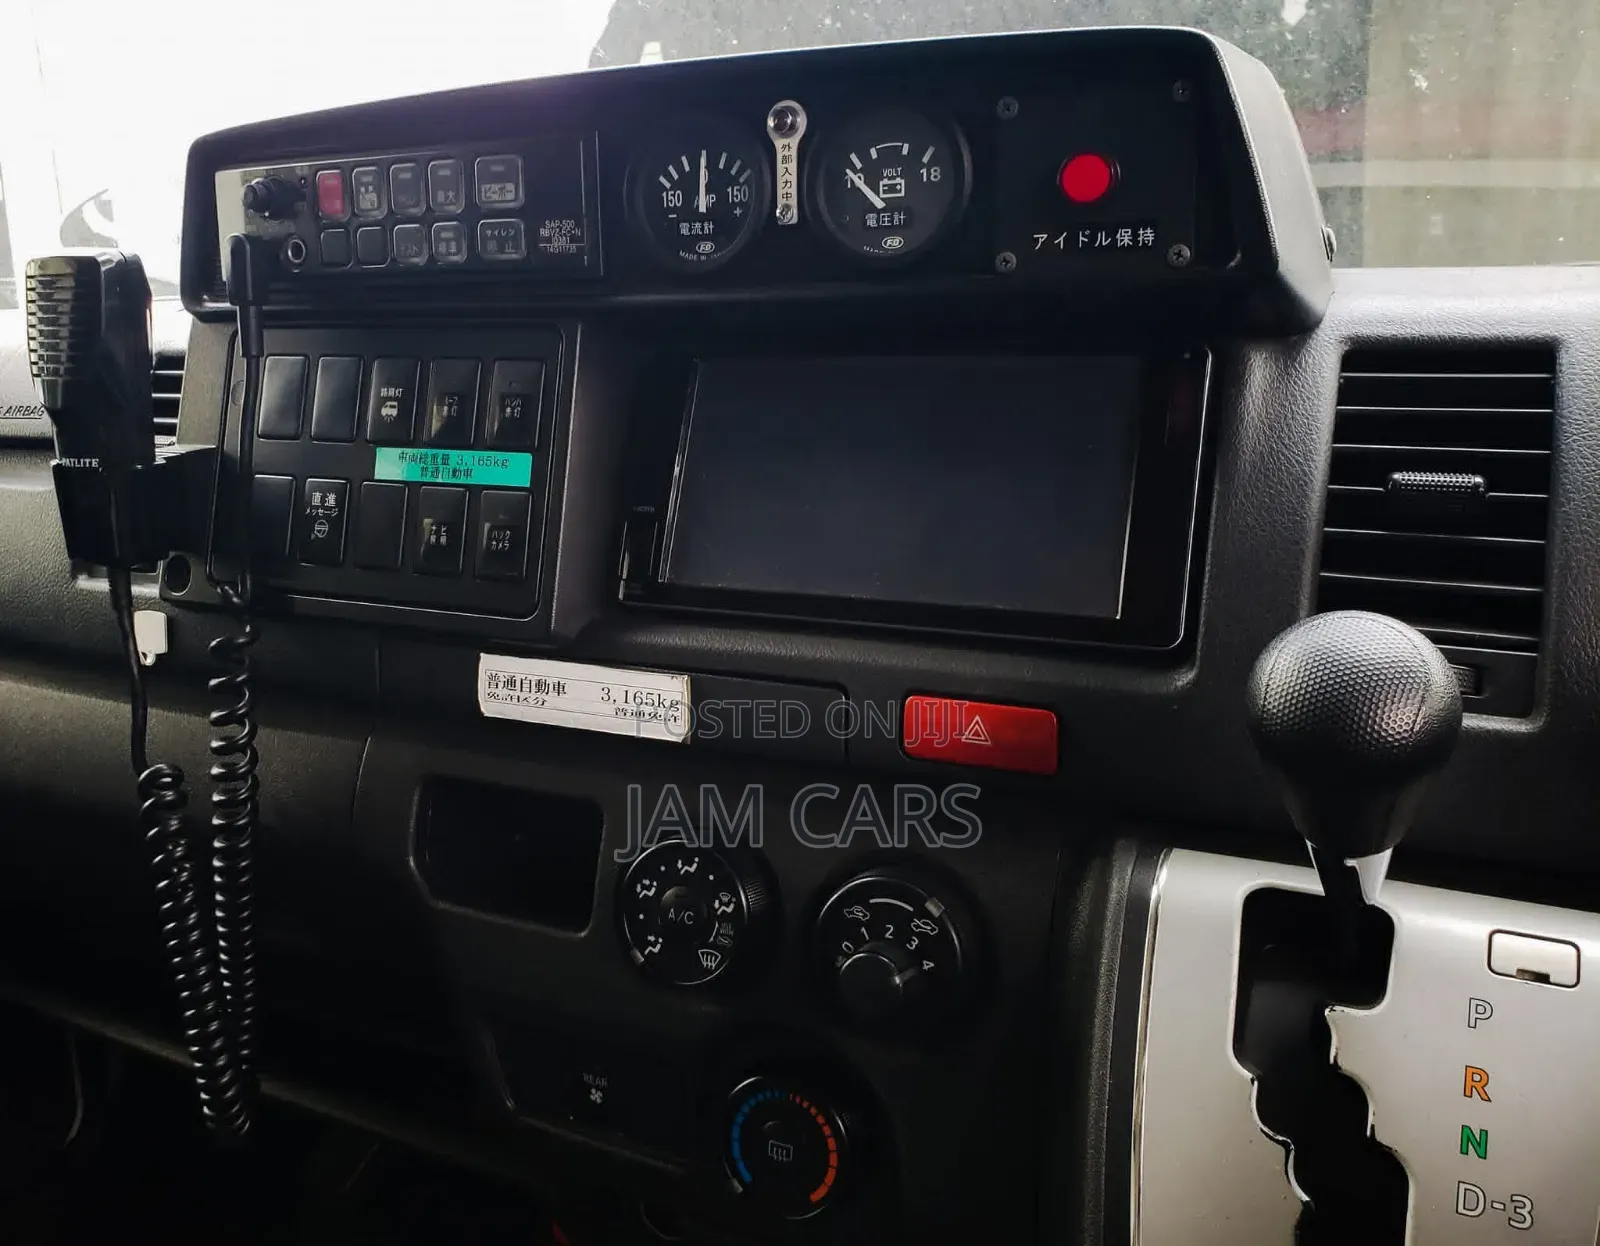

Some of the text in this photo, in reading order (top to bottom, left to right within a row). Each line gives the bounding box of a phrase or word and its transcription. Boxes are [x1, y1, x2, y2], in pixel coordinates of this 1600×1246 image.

[780, 142, 794, 202] 外部入力中
[882, 167, 902, 177] VOLT
[920, 167, 941, 182] 18
[662, 189, 683, 208] 150
[727, 184, 749, 204] 150
[865, 211, 907, 227] 電圧計
[485, 227, 516, 237] サイレン
[679, 220, 715, 236] 電流計
[1032, 227, 1157, 250] アイドル保持
[4, 405, 45, 417] AIRBAG
[456, 454, 510, 469] 3,165kg
[420, 466, 474, 480] 普通自動車
[311, 491, 337, 506] 直進
[304, 507, 339, 517] メッセージ
[487, 673, 681, 712] 普通自動車 3,165kg
[668, 908, 695, 926] A/C
[860, 927, 870, 941] 1
[884, 925, 895, 940] 2
[841, 940, 856, 955] 0
[906, 936, 919, 951] 3
[921, 959, 936, 972] 4
[1467, 997, 1494, 1029] P
[1463, 1065, 1492, 1103] R
[1459, 1124, 1489, 1160] N
[1455, 1180, 1535, 1231] D-3
